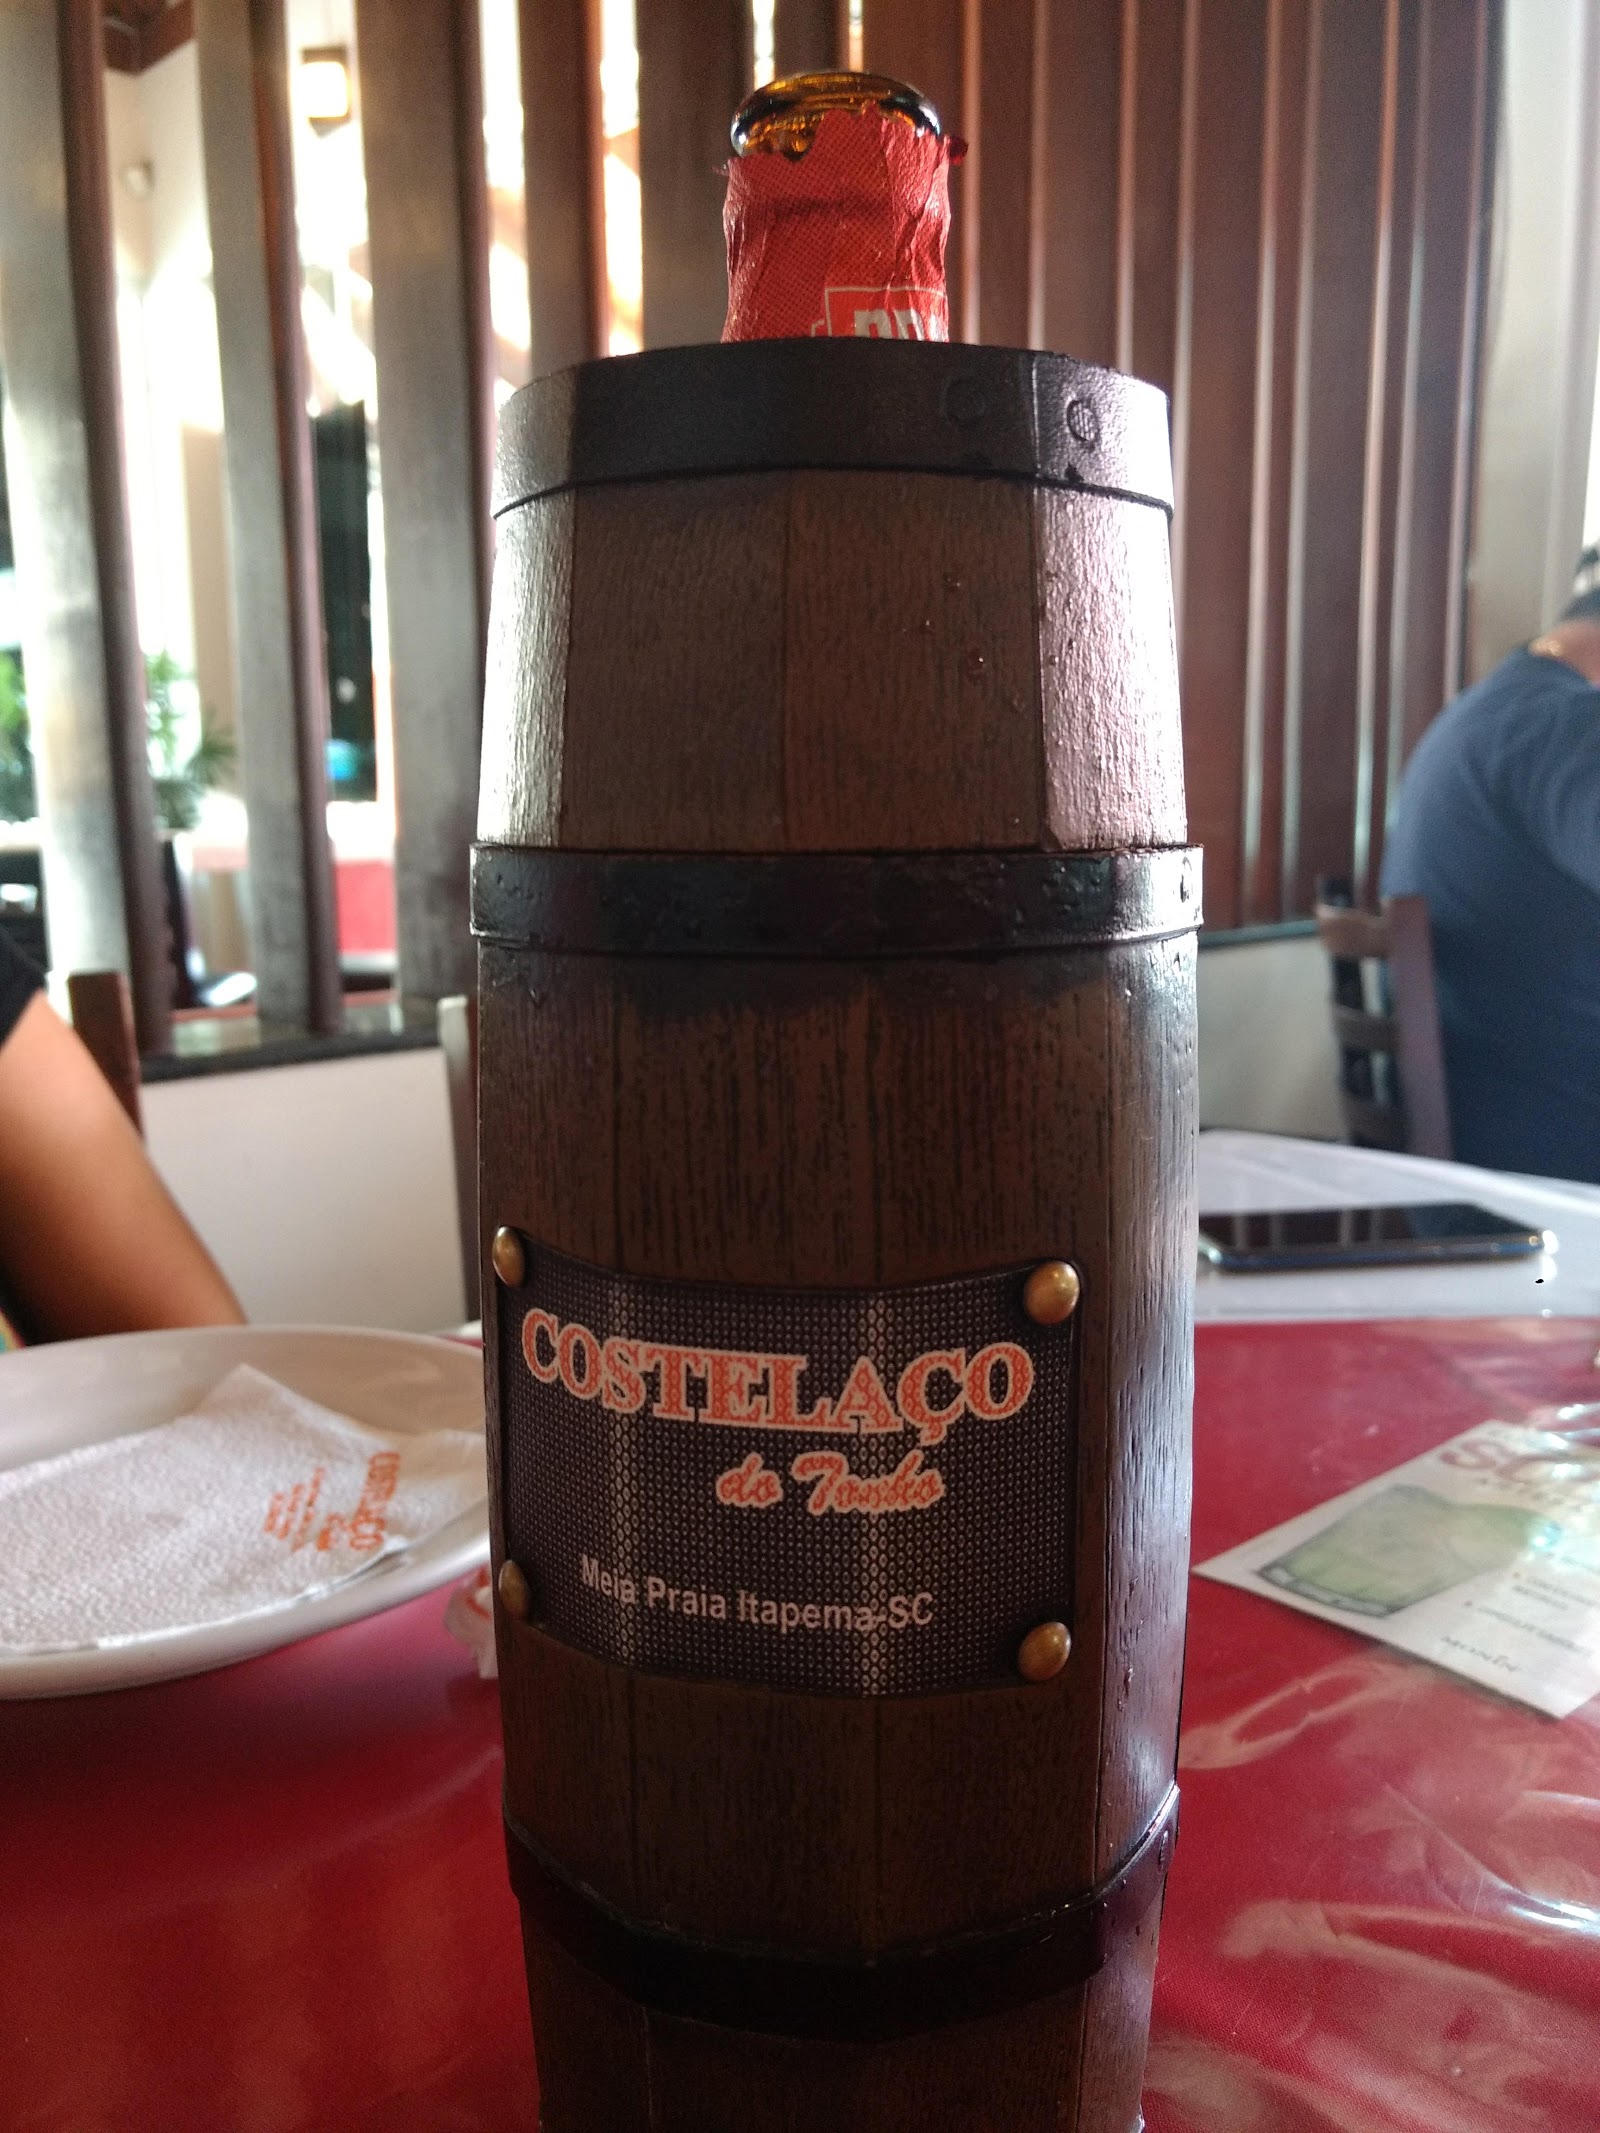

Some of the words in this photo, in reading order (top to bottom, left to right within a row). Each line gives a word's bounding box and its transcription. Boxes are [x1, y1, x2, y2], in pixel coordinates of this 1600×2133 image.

[522, 1309, 1034, 1445] COSTELAÇO
[581, 1553, 638, 1604] Meia
[646, 1575, 727, 1619] Praia
